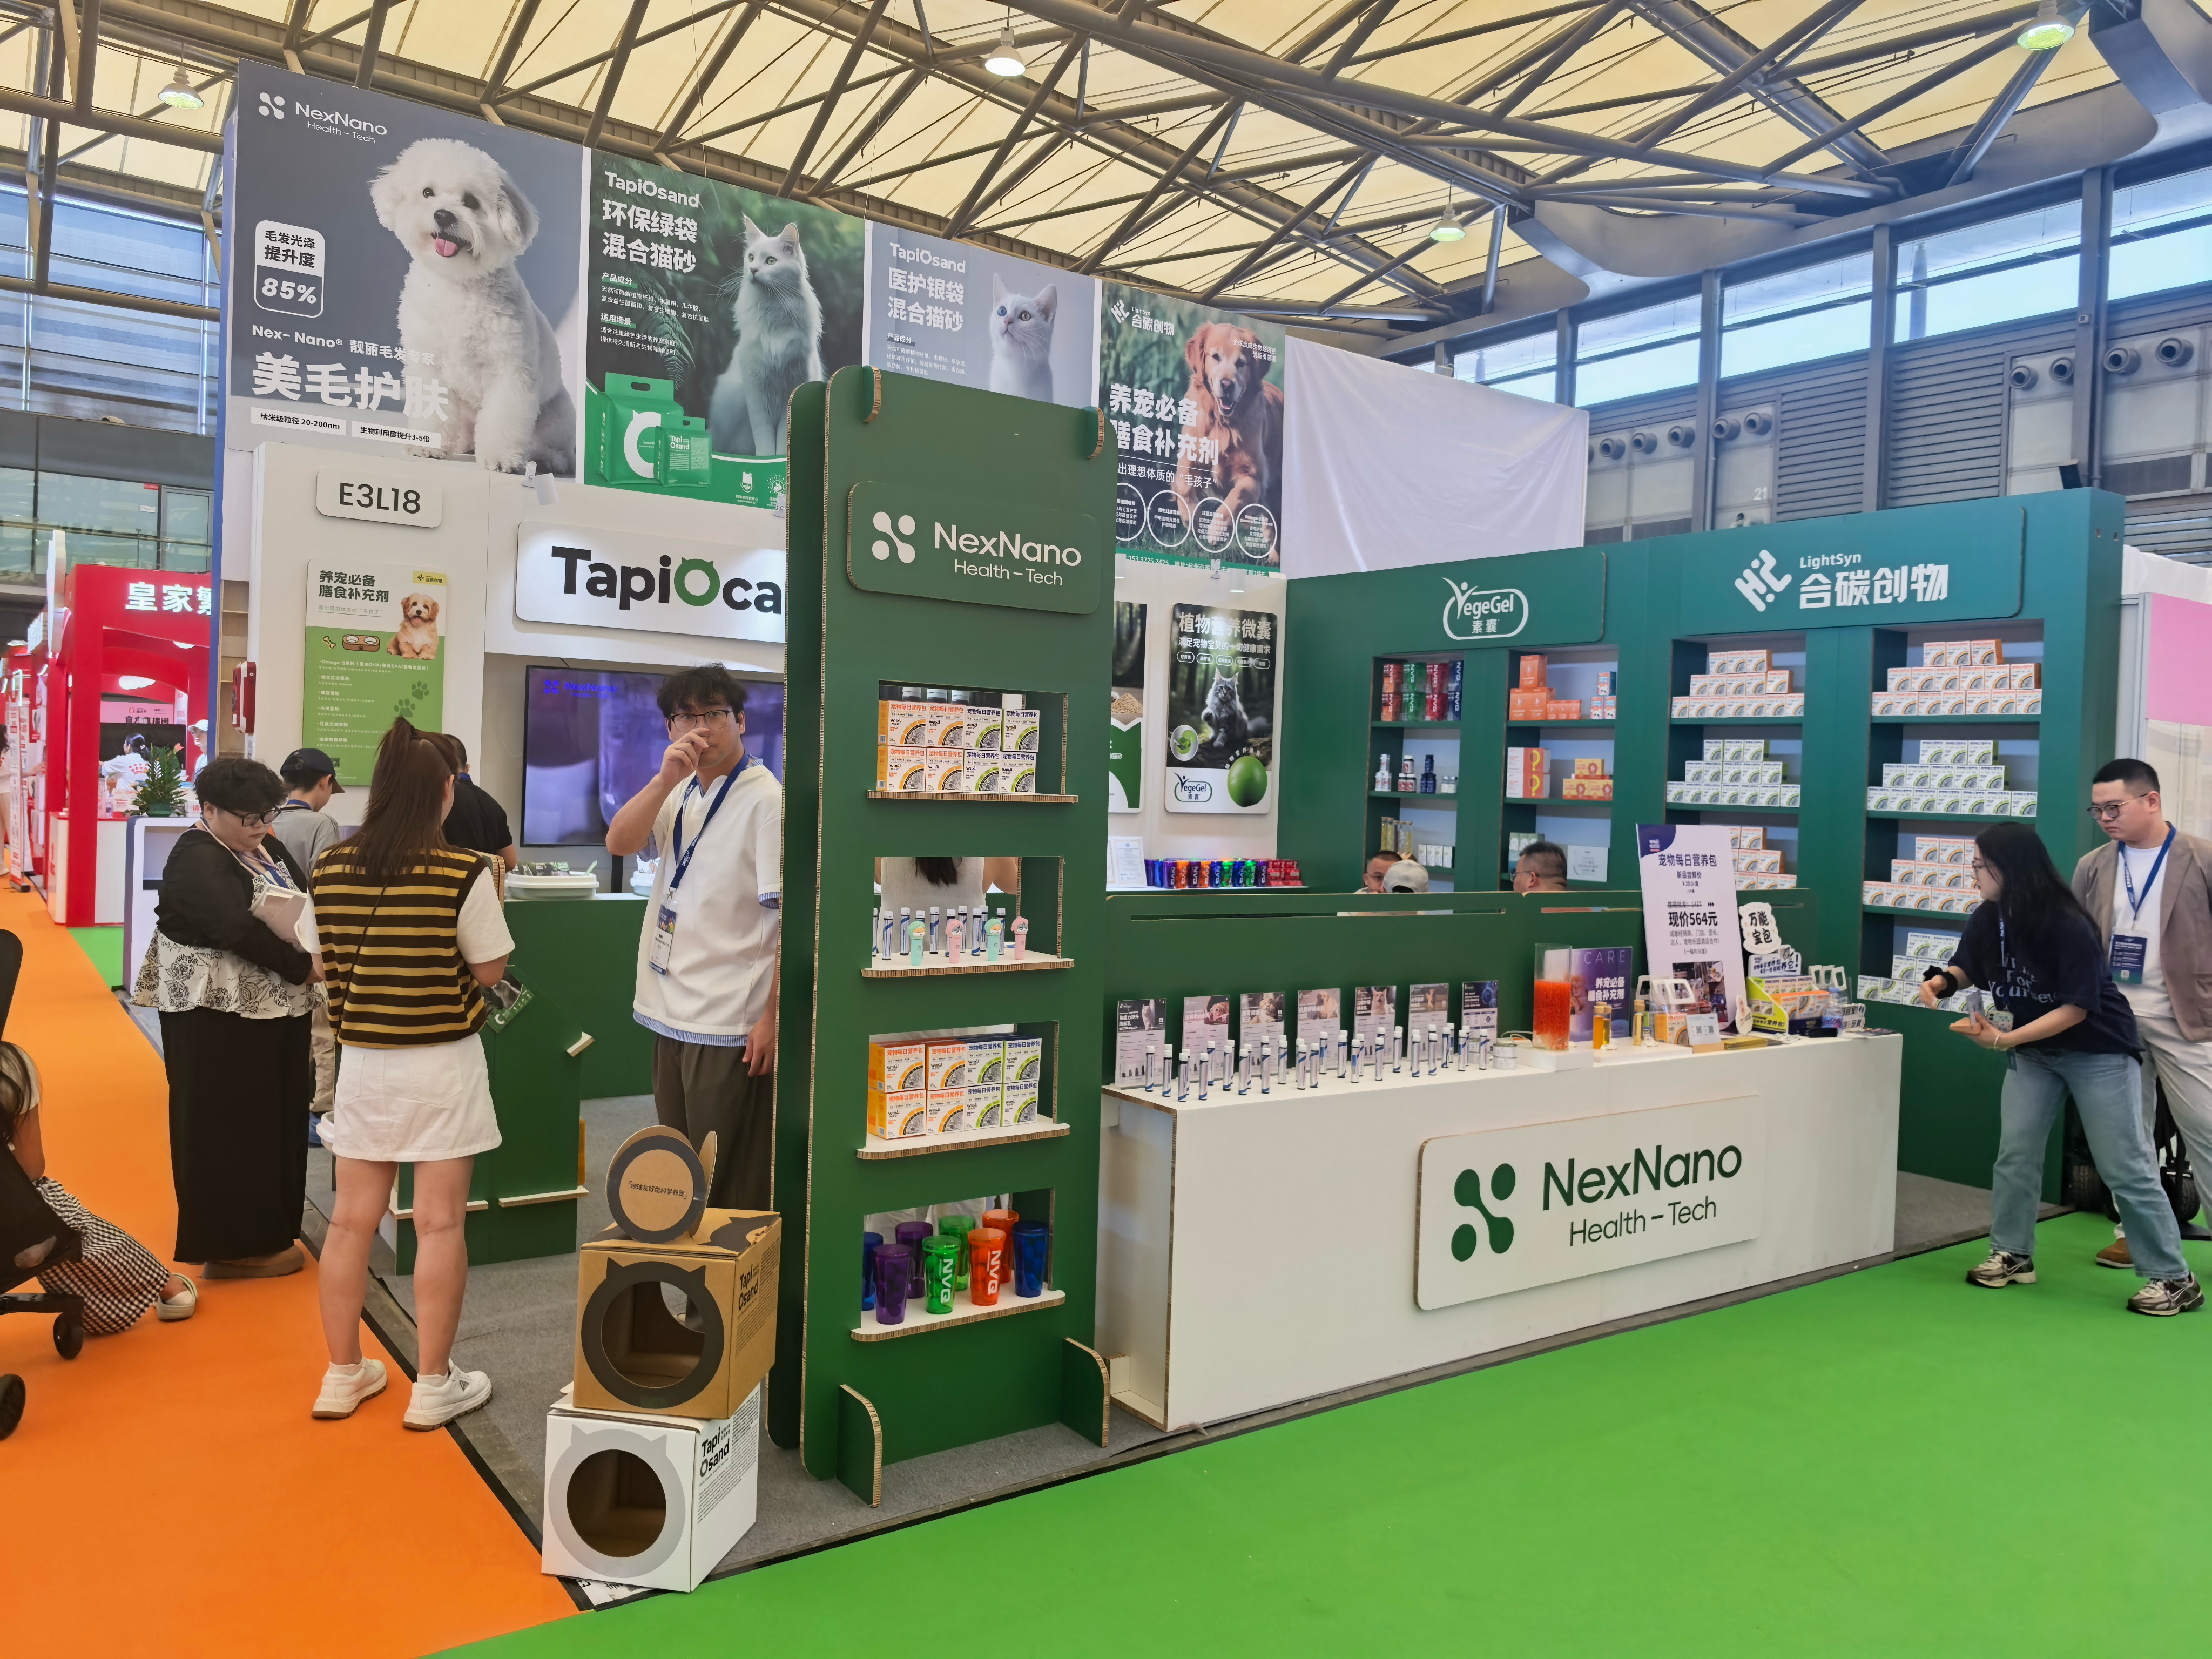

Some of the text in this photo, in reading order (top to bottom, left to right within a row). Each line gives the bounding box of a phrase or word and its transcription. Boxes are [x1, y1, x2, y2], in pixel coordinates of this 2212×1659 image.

[296, 102, 387, 135] NexNano
[308, 121, 375, 143] Health Tech
[605, 171, 699, 208] TapiOsand
[603, 199, 697, 243] 环保绿袋
[265, 231, 315, 249] 毛发光泽
[265, 245, 315, 268] 提升度
[602, 232, 696, 273] 混合猫砂
[889, 242, 966, 273] TapiOsand
[602, 272, 632, 285] 产品成分
[888, 268, 964, 305] 医护银袋
[262, 278, 316, 304] 85%
[601, 313, 631, 326] 适用场景
[887, 296, 963, 332] 混合猫砂
[1132, 307, 1151, 316] LightSyn
[1132, 314, 1175, 336] 合碳创物
[887, 333, 912, 344] 产品成分
[350, 339, 435, 366] 靓丽毛发专家
[1252, 351, 1277, 362] 创新引领者
[252, 352, 448, 422] 美毛护肤
[1109, 382, 1199, 427] 养宠必备
[260, 414, 340, 429] 纳米级粒径 20-200nm
[360, 427, 430, 443] 生物利用度提升3-5倍
[1109, 419, 1219, 466] 膳食补充剂
[340, 482, 421, 514] E3L18
[1754, 487, 1767, 500] 21
[934, 522, 1081, 567] NexNano
[1800, 553, 1861, 570] LightSyn
[320, 570, 376, 588] 养宠必备
[551, 546, 783, 614] TapiOca
[954, 559, 1062, 586] Health Tech
[319, 584, 389, 602] 膳食补充剂
[1799, 563, 1948, 609] 合碳创物
[1179, 612, 1271, 640] 植物营养微囊
[1178, 637, 1270, 655] 满足宠物宝贝的一切健康需求
[564, 682, 617, 692] NexNano
[891, 703, 926, 711] 宠物每日营养包
[1658, 854, 1717, 867] 宠物每日营养包
[1668, 911, 1718, 927] 现价564元
[1749, 911, 1769, 927] 万能
[1752, 928, 1772, 945] 宝包
[1596, 977, 1624, 988] 养宠必备
[887, 1047, 923, 1056] 宠物每日营养包
[932, 1047, 966, 1055] 宠物每日营养包
[969, 1043, 1002, 1051] 宠物每日营养包
[1008, 1041, 1040, 1049] 宠物每日营养包
[930, 1091, 964, 1100] 宠物每日营养包
[968, 1086, 1000, 1095] 宠物每日营养包
[1006, 1083, 1037, 1091] 宠物每日营养包
[888, 1092, 924, 1102] 宠物每日营养包
[1542, 1145, 1742, 1211] NexNano
[1570, 1196, 1716, 1246] Health Tech
[740, 1264, 753, 1291] Tapi
[738, 1278, 758, 1311] Osand
[702, 1426, 720, 1457] Tapi
[700, 1438, 729, 1477] Osand
